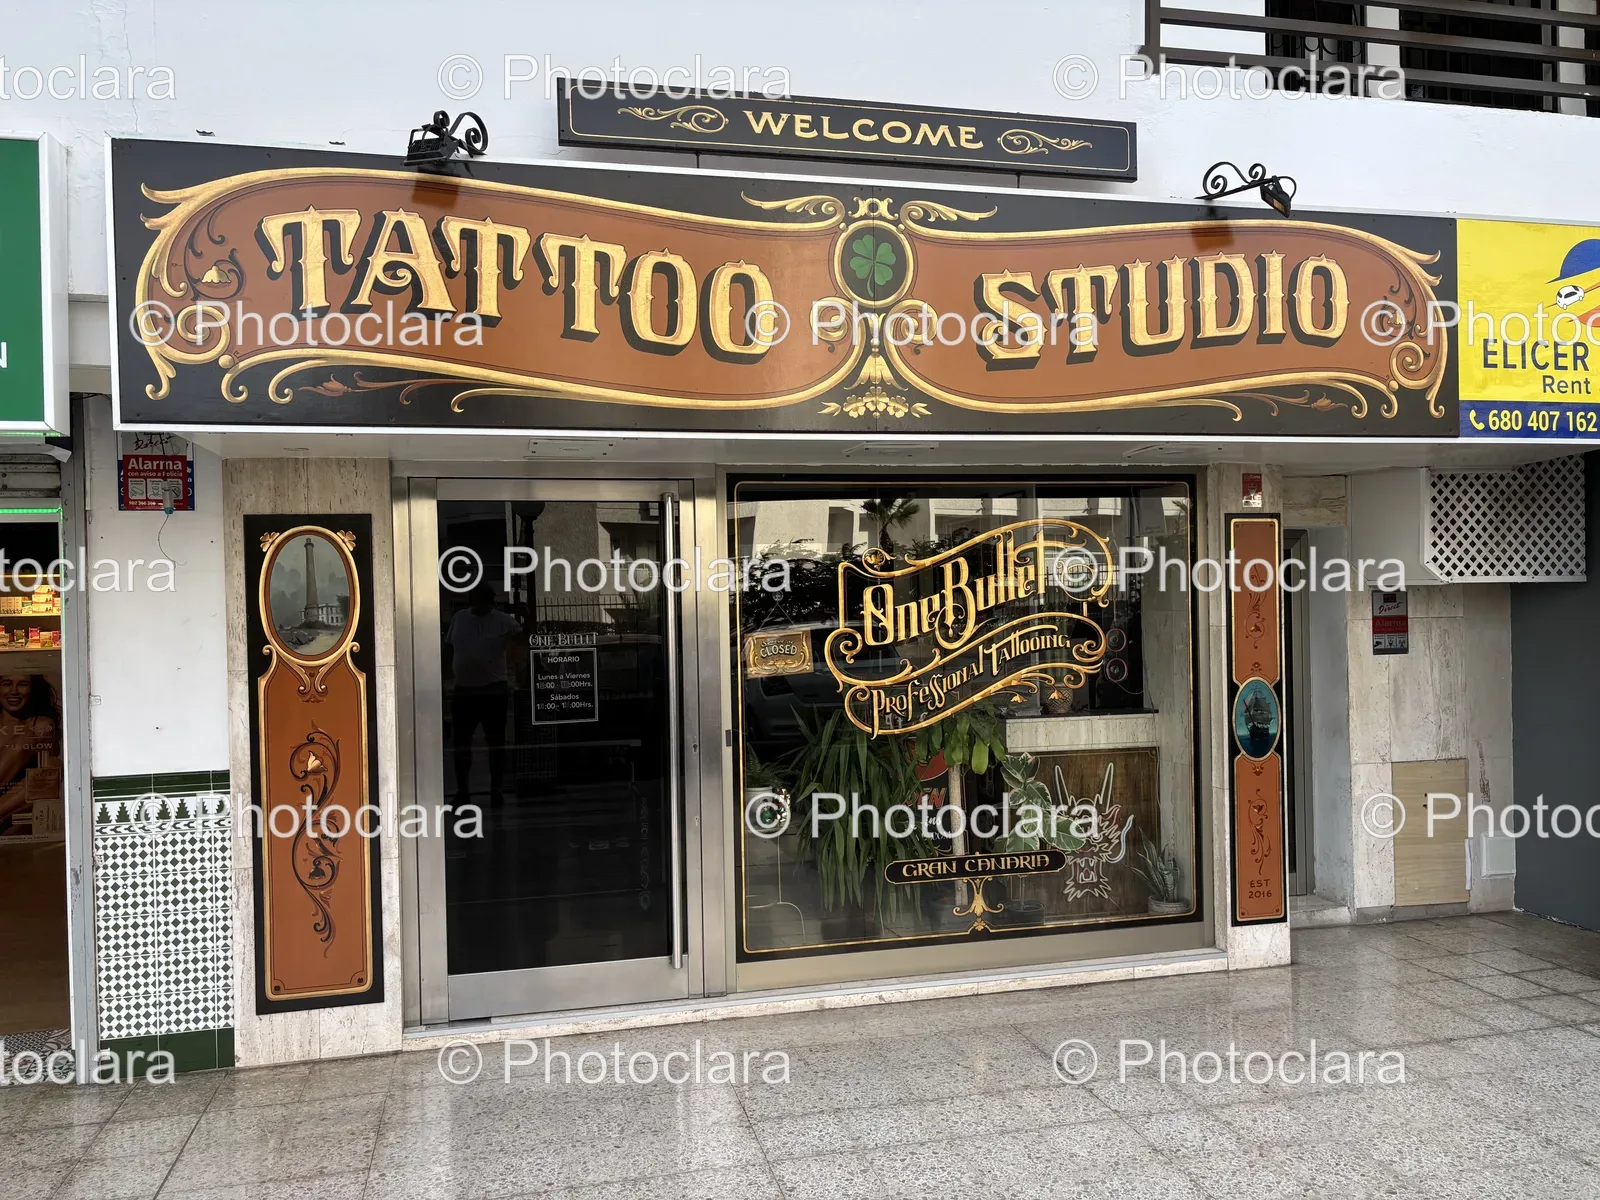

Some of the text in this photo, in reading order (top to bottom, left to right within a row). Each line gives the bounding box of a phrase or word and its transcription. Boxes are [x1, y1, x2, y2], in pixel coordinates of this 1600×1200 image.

[743, 110, 984, 150] WELCOME
[254, 203, 1350, 371] TATTOO STUDIO
[1483, 338, 1590, 371] ELICER
[1542, 375, 1591, 394] Rent
[1488, 409, 1598, 431] 680 407 162
[128, 457, 183, 470] Alarma
[860, 529, 1087, 650] One Bullet
[547, 655, 580, 663] HORARIO
[760, 644, 798, 658] CLOSED
[565, 672, 591, 680] Viernes
[550, 692, 580, 701] Sábados
[902, 854, 1049, 878] GRAN CANARIA
[1249, 878, 1271, 888] EST
[1248, 889, 1273, 899] 2016
